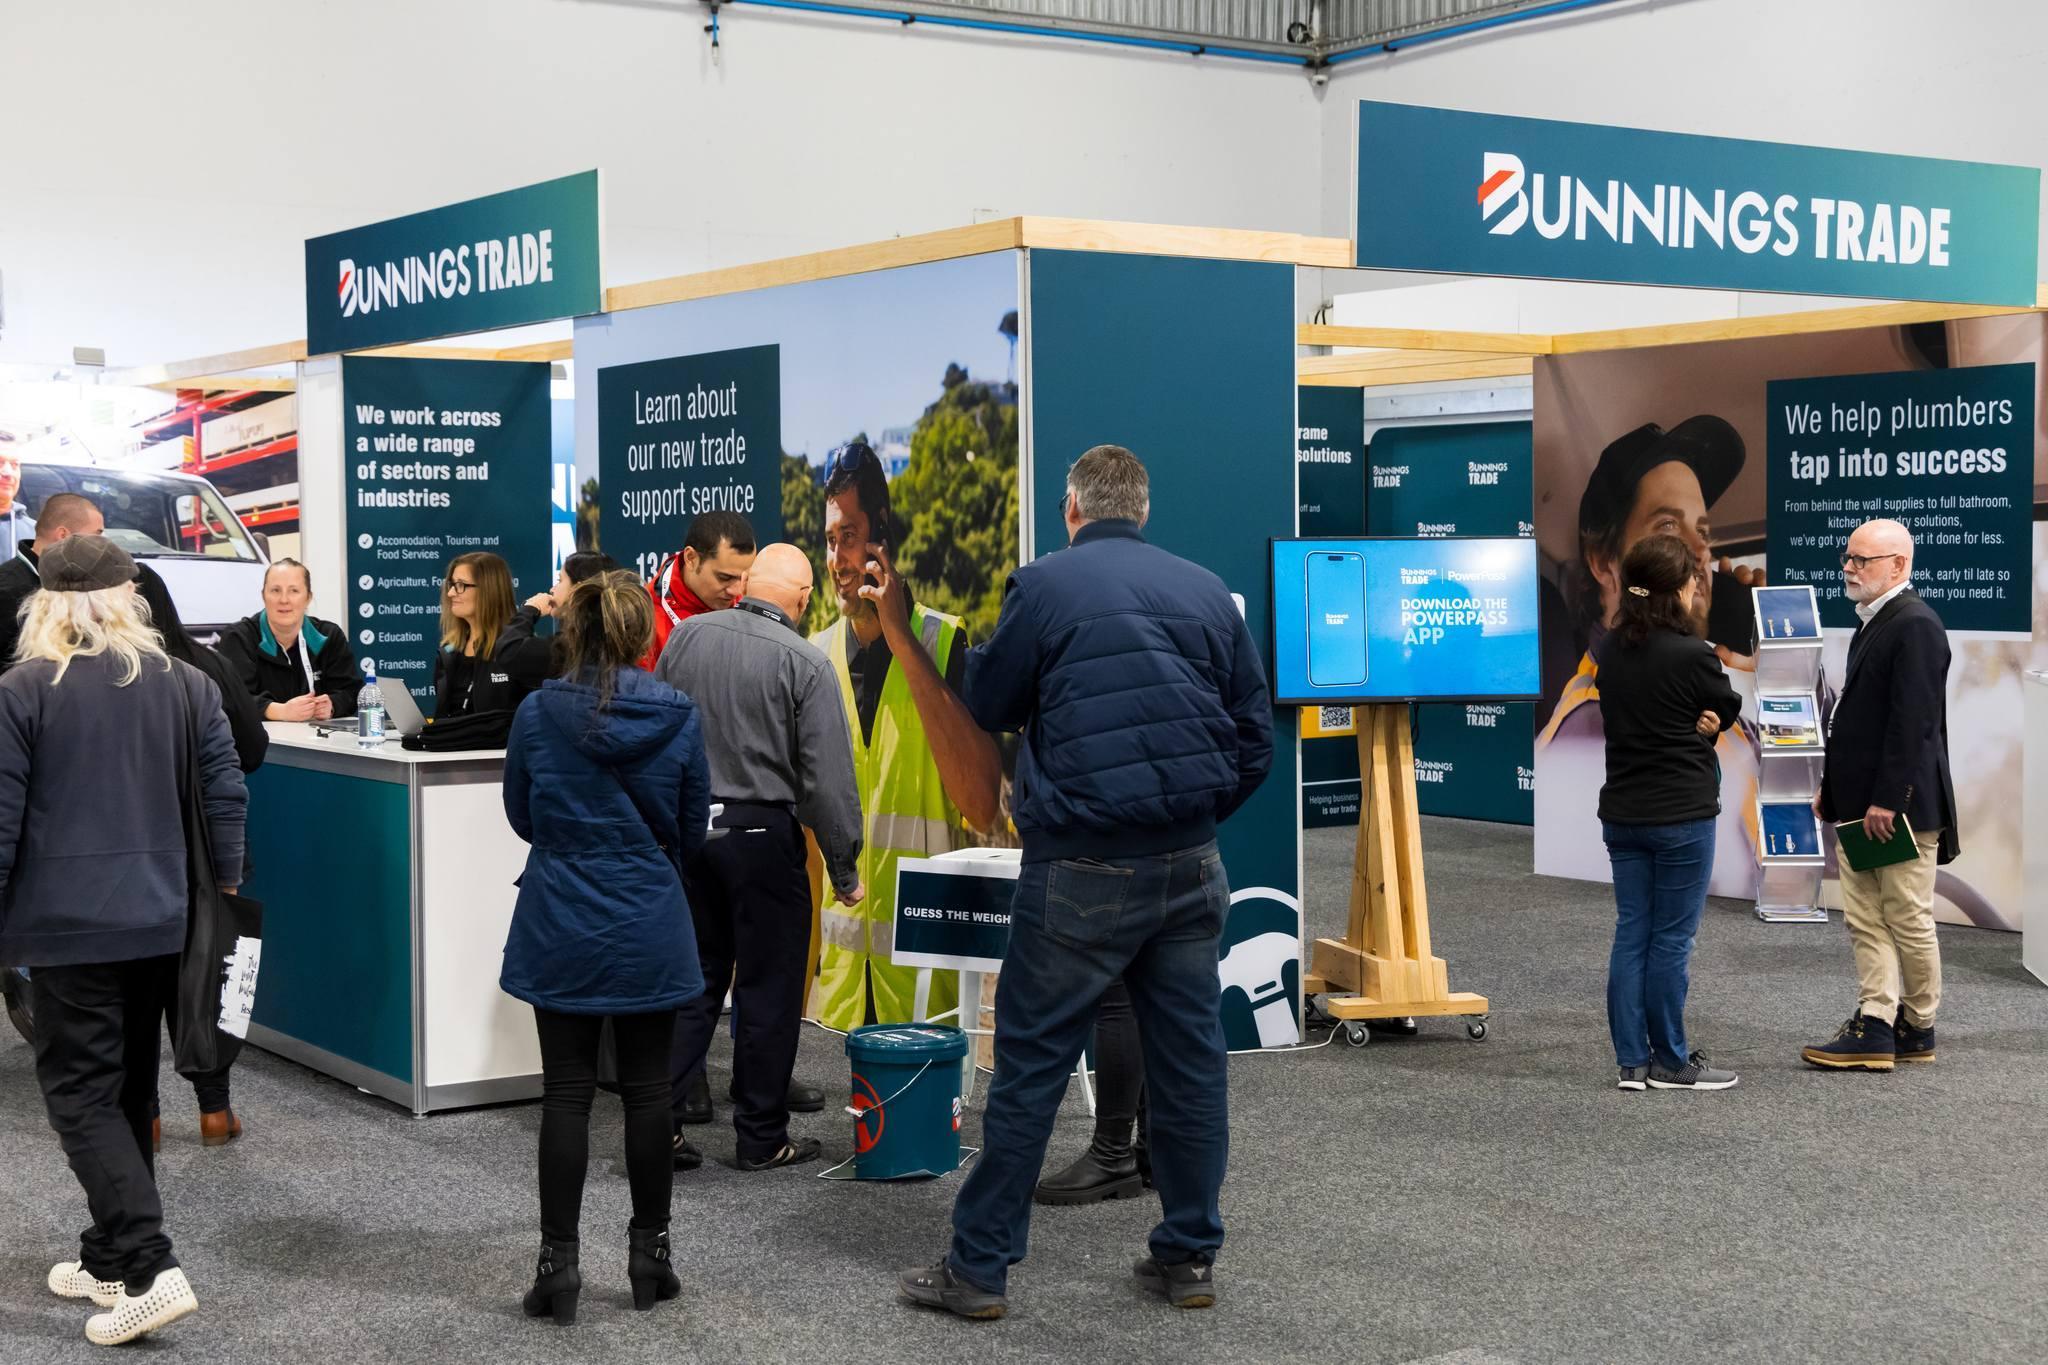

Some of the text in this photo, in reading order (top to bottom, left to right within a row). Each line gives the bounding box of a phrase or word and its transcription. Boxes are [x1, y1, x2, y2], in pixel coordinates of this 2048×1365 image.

[1477, 152, 1951, 267] BUNNINGS TRADE
[338, 229, 554, 317] BUNNINGS TRADE
[635, 381, 738, 425] Learn about
[355, 404, 502, 427] We work across
[1785, 395, 2013, 438] We help plumbers
[356, 433, 475, 457] a wide range
[628, 428, 746, 472] our new trade
[1297, 446, 1352, 464] solutions
[357, 461, 489, 480] of sectors and
[1372, 465, 1410, 475] BUNNINGS
[1468, 461, 1508, 472] BUNNINGS
[1790, 447, 2008, 485] tap into success
[1373, 475, 1401, 488] TRADE
[1468, 471, 1498, 485] TRADE
[357, 488, 451, 507] industries
[622, 481, 686, 525] support
[691, 477, 754, 515] service
[1784, 495, 2012, 512] From behind the wall supplies to full bathroom,
[1309, 504, 1321, 513] and
[1417, 522, 1456, 533] BUNNINGS
[1828, 515, 1862, 528] kitchen
[1914, 514, 1963, 527] solutions,
[377, 535, 500, 548] Accomodation, Tourism and
[1790, 534, 1816, 546] we've
[1818, 536, 1833, 548] got
[1927, 533, 1933, 544] it
[1936, 532, 1961, 545] done
[1964, 531, 1978, 544] for
[1981, 531, 2005, 544] less.
[377, 549, 439, 560] Food Services
[377, 576, 430, 588] Agriculture,
[1401, 576, 1428, 585] TRADE
[1785, 568, 1808, 582] Plus,
[1810, 569, 1836, 581] we're
[1937, 567, 1961, 583] early
[1964, 567, 1974, 580] til
[1976, 567, 1995, 581] late
[1997, 570, 2011, 581] so
[1826, 586, 1841, 600] get
[1918, 587, 1944, 599] when
[1947, 588, 1966, 601] you
[1969, 587, 1993, 599] need
[1996, 587, 2006, 599] it.
[378, 604, 443, 615] Child Care and
[1401, 598, 1508, 610] DOWNLOAD THE
[1401, 611, 1508, 626] POWERPASS
[378, 632, 423, 642] Education
[1402, 628, 1445, 645] APP
[378, 659, 427, 670] Franchises
[410, 686, 427, 697] and
[1466, 714, 1496, 727] TRADE
[1415, 758, 1453, 771] BUNNINGS
[1415, 770, 1444, 783] TRADE
[1309, 793, 1359, 806] Helping business
[1322, 804, 1360, 815] is our trade.
[903, 906, 943, 919] GUESS
[946, 909, 970, 921] THE
